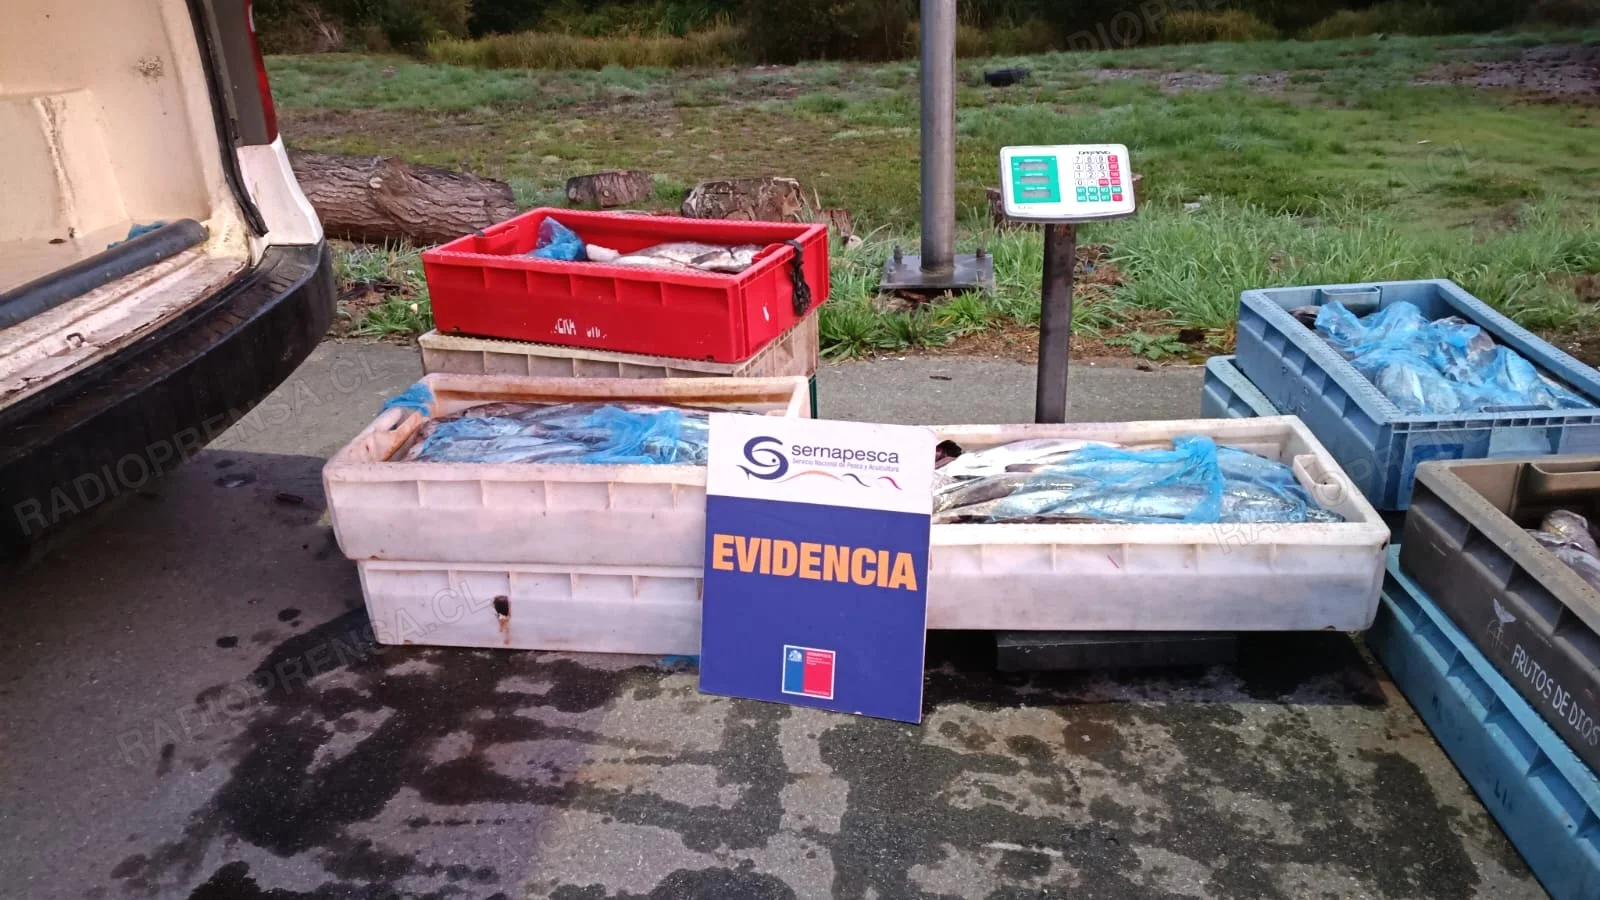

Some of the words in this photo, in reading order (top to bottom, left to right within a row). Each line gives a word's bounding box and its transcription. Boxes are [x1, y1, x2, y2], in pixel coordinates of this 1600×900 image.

[791, 445, 899, 464] sernapesca
[712, 534, 918, 591] EVIDENCIA
[1511, 644, 1554, 698] FRUTOS
[1552, 685, 1571, 717] DE
[1568, 701, 1600, 746] DIOS
